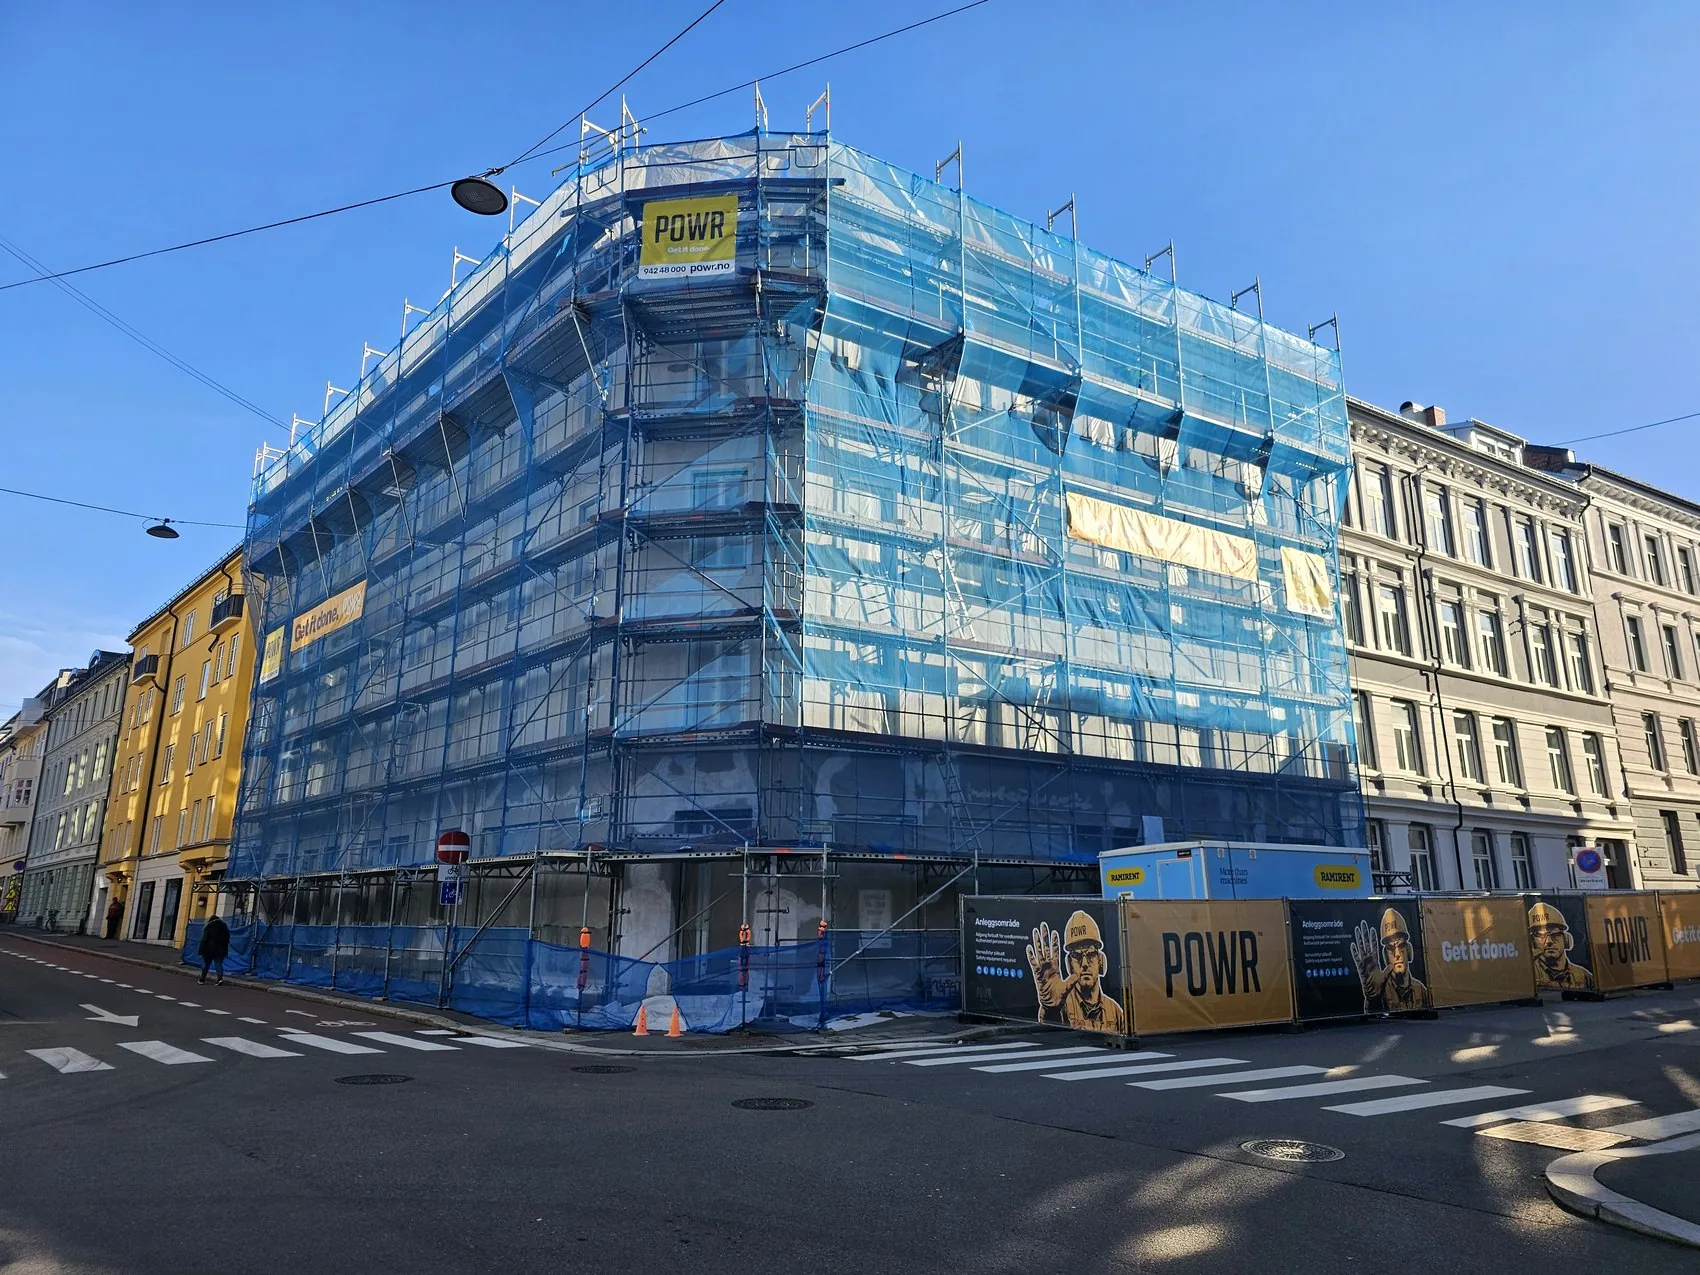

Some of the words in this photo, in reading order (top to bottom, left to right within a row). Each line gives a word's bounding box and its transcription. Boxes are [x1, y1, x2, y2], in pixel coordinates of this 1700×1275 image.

[655, 211, 724, 243] POWR
[668, 246, 682, 254] Get
[644, 267, 659, 275] 942
[690, 262, 730, 274] powr.no
[295, 619, 309, 642] Get
[1111, 872, 1140, 882] RAMIRENT
[1320, 872, 1355, 882] RAMIRENT
[975, 918, 1020, 928] Anleggsområde
[1071, 925, 1087, 938] POWR
[1604, 916, 1651, 965] POWR
[1441, 940, 1469, 961] Get
[1469, 939, 1480, 960] it
[1481, 939, 1518, 960] done.
[1162, 931, 1261, 998] POWR
